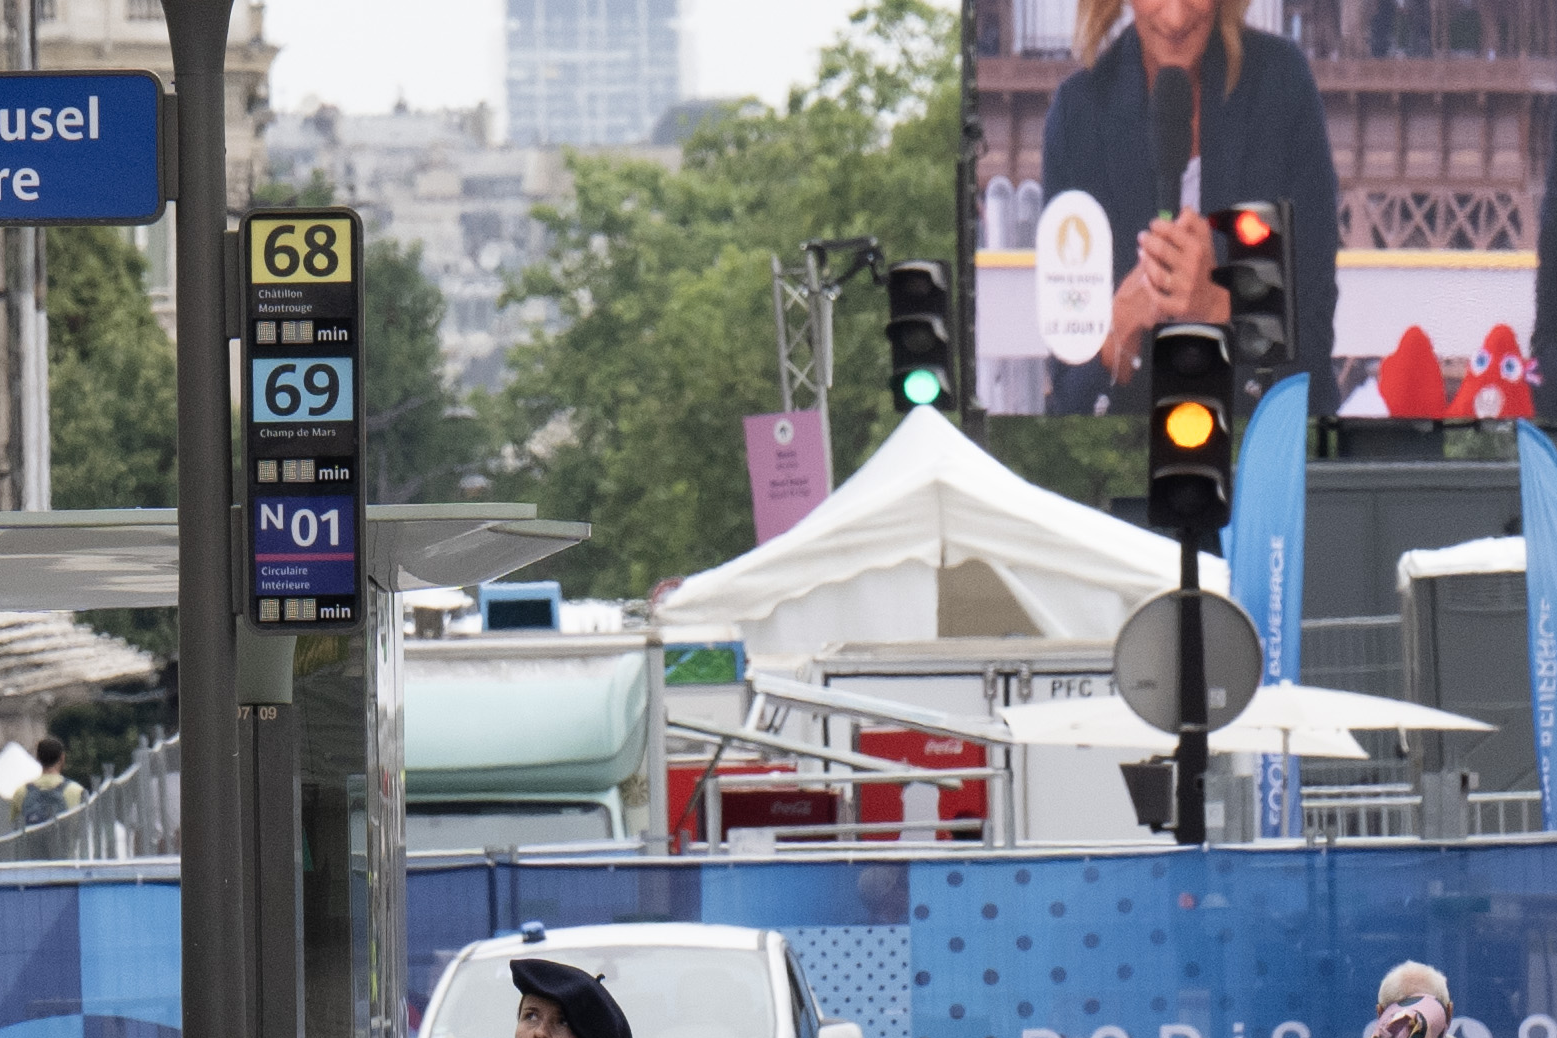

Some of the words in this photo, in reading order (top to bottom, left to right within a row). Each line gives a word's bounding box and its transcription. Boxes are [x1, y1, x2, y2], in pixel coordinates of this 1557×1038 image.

[263, 223, 339, 278] 68
[258, 288, 303, 299] Châtillon
[258, 303, 313, 313] Montrouge
[317, 325, 349, 341] min
[265, 363, 340, 416] 69
[259, 428, 294, 438] Champ
[297, 427, 309, 437] de
[312, 428, 336, 437] Mars
[319, 464, 350, 480] min
[261, 566, 308, 575] Circulaire
[261, 580, 311, 590] Intérieure
[320, 604, 352, 619] min
[1052, 679, 1093, 698] PFC
[259, 706, 277, 720] 09
